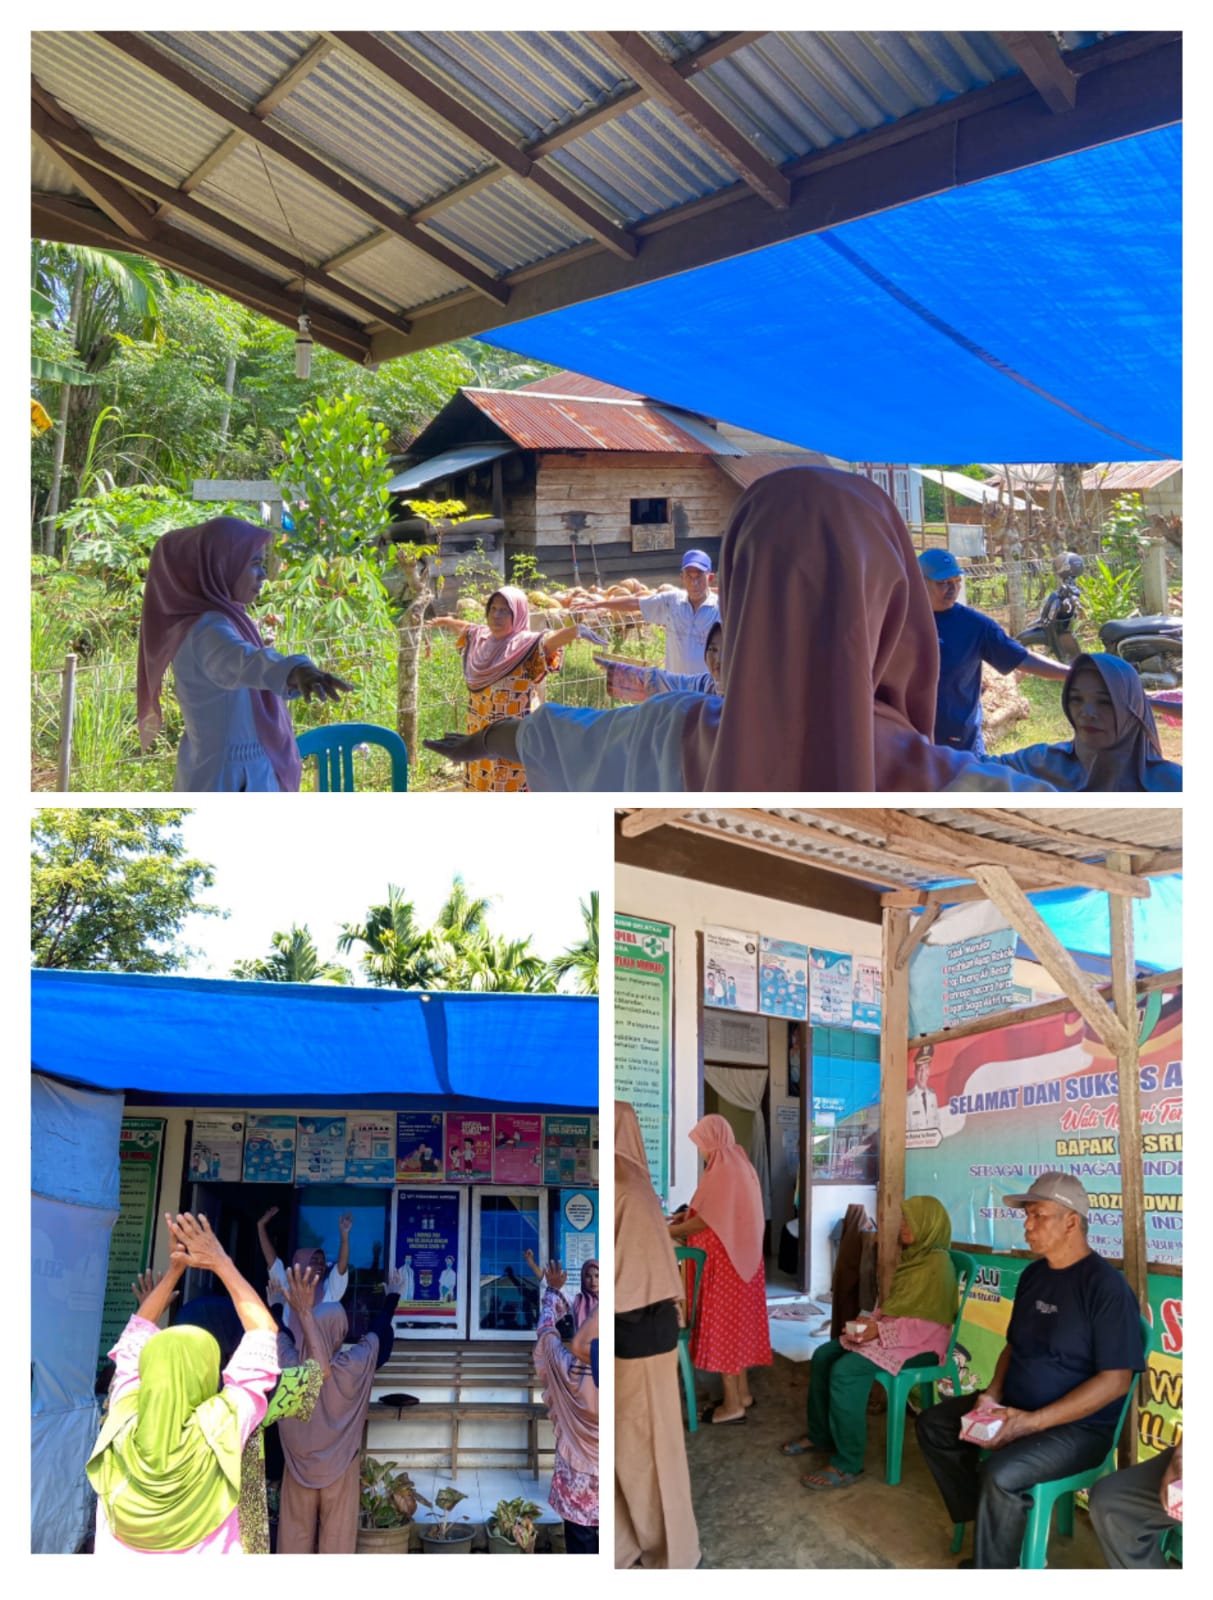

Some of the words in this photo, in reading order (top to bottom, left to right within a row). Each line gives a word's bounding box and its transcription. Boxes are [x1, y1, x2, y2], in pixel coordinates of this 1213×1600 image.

[950, 1087, 1019, 1115] SELAMAT
[1023, 1080, 1061, 1107] DAN
[1065, 1064, 1158, 1101] SUKSS
[1060, 1103, 1098, 1131] Wali
[1102, 1103, 1156, 1131] Nri
[1056, 1136, 1116, 1157] BAPAK
[1070, 1160, 1122, 1176] NAGA
[980, 1207, 1027, 1219] SEBAG
